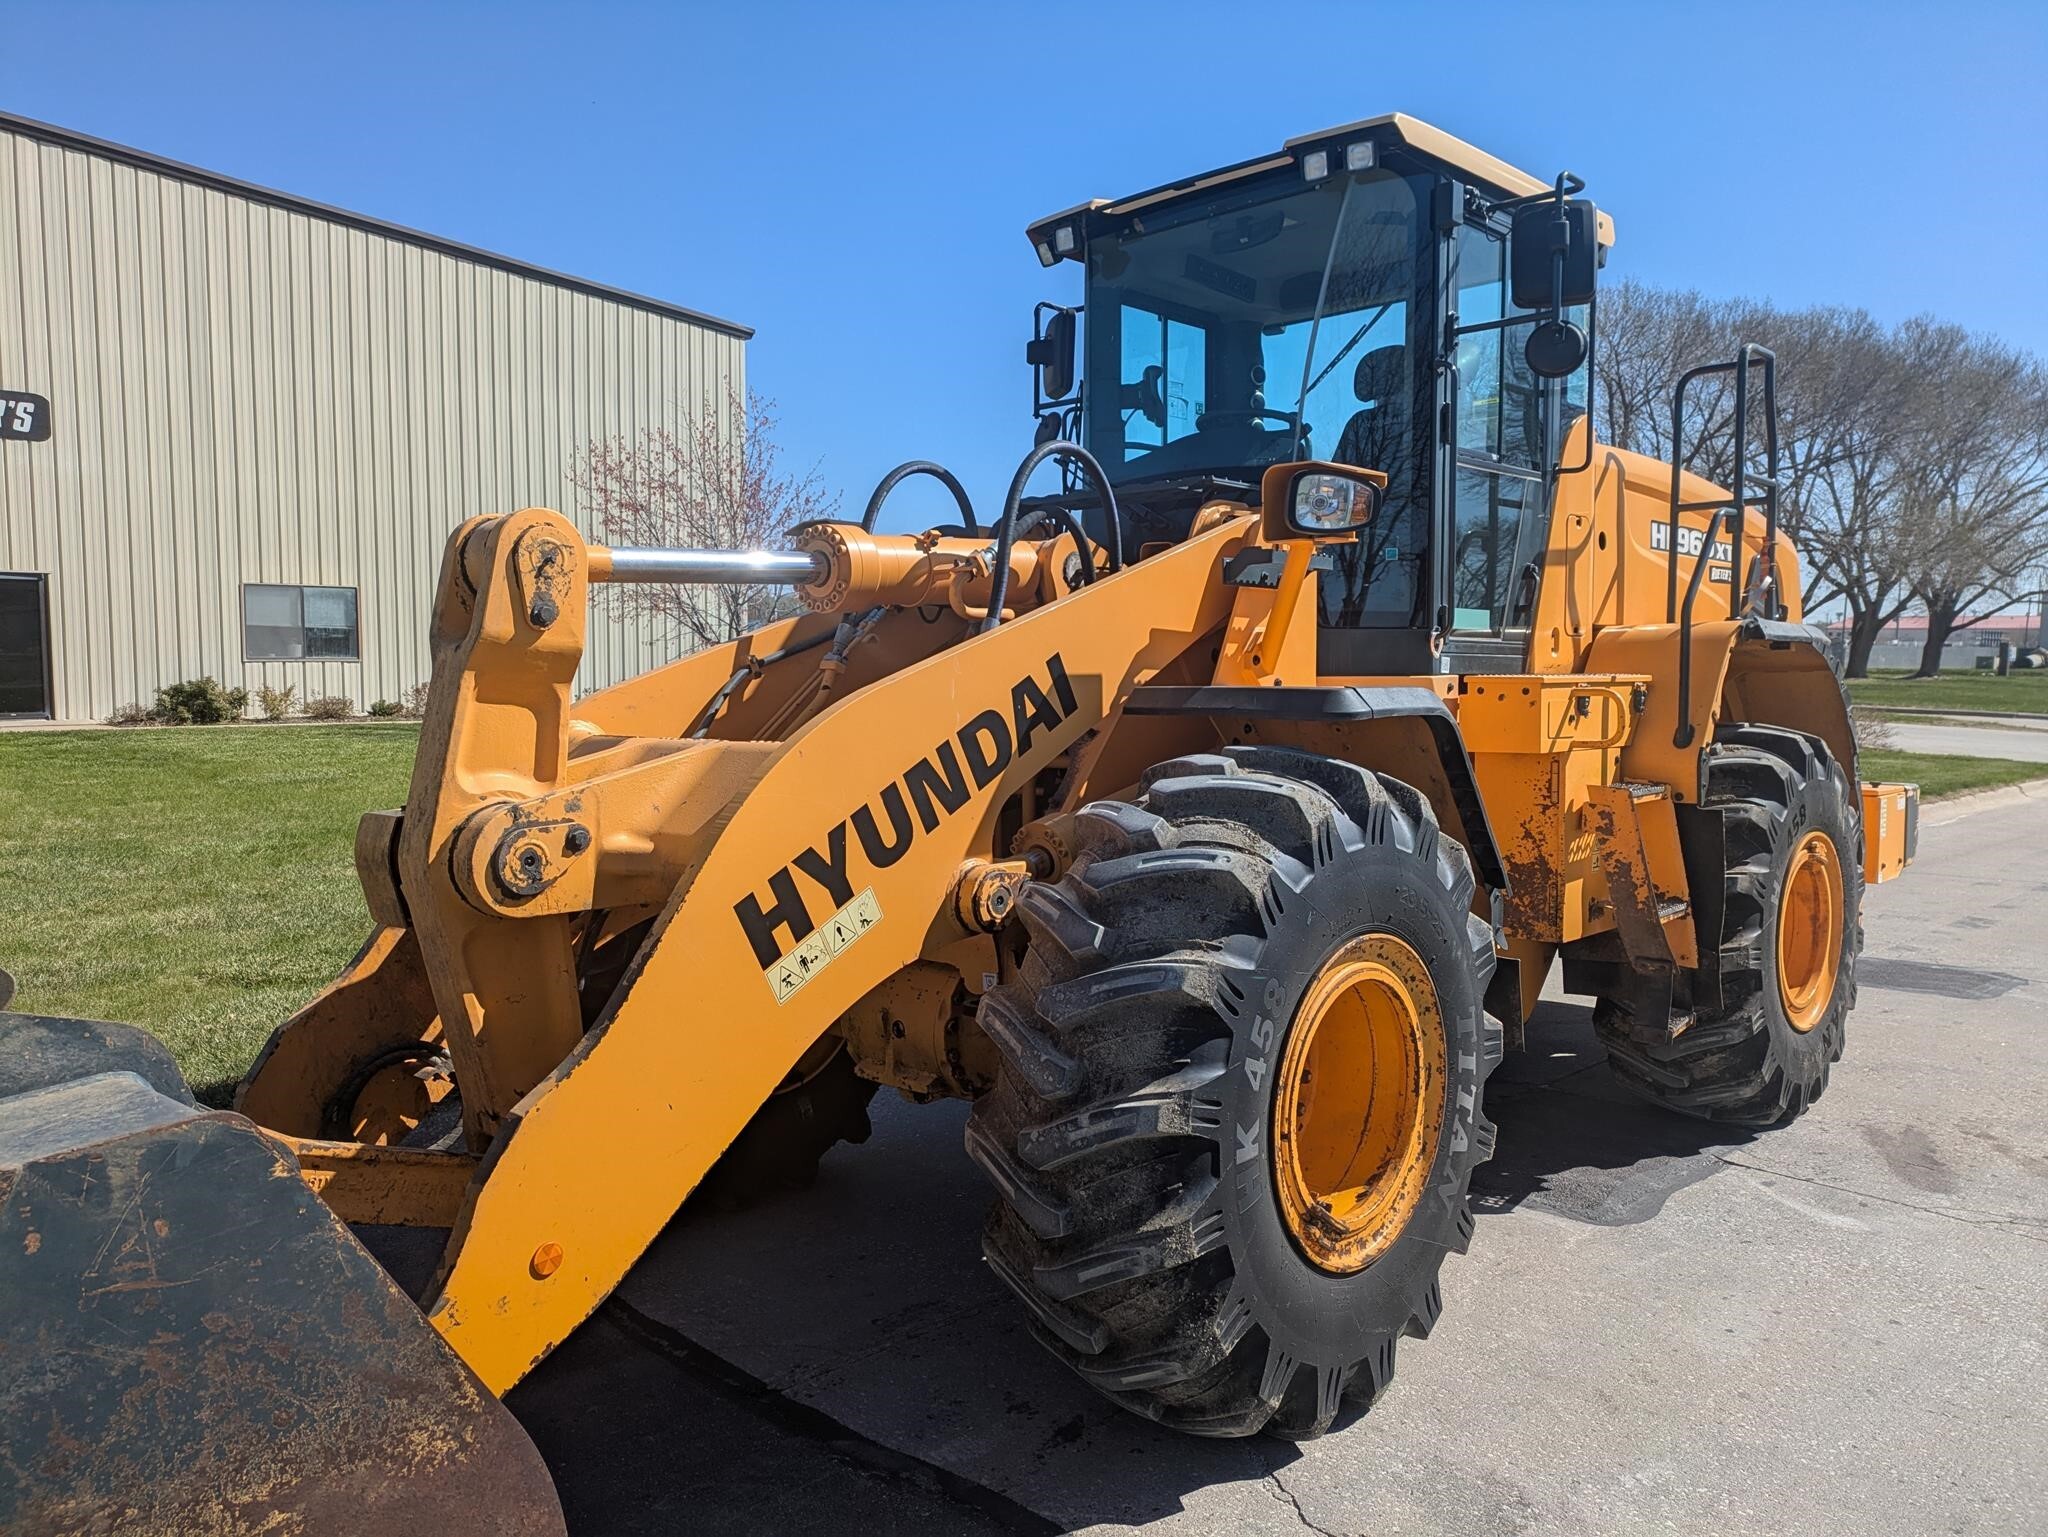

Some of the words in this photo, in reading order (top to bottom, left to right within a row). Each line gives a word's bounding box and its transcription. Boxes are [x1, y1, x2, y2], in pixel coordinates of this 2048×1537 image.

[0, 399, 35, 433] 'S
[733, 652, 1079, 971] HYUNDAI
[1244, 977, 1287, 1092] 458
[1438, 1005, 1478, 1219] TITAN
